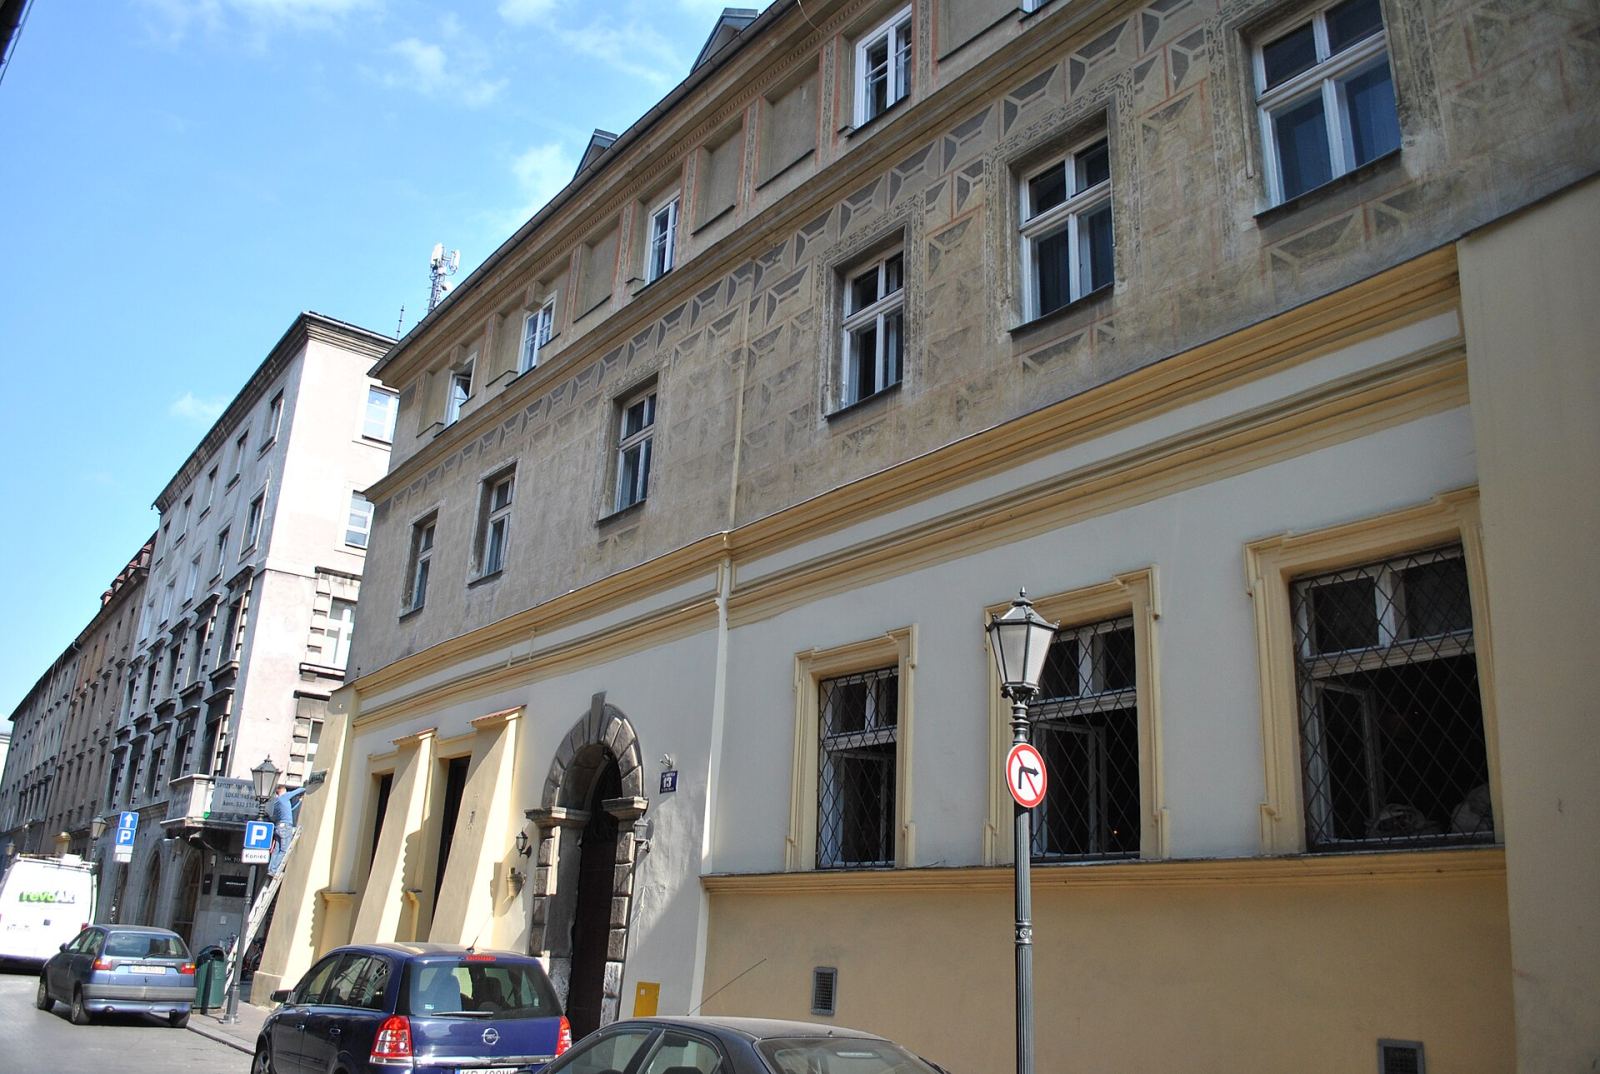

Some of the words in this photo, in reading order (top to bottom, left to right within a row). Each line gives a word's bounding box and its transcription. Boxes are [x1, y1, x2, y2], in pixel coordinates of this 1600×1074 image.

[664, 776, 672, 788] 13
[119, 830, 132, 844] P
[250, 825, 268, 846] P
